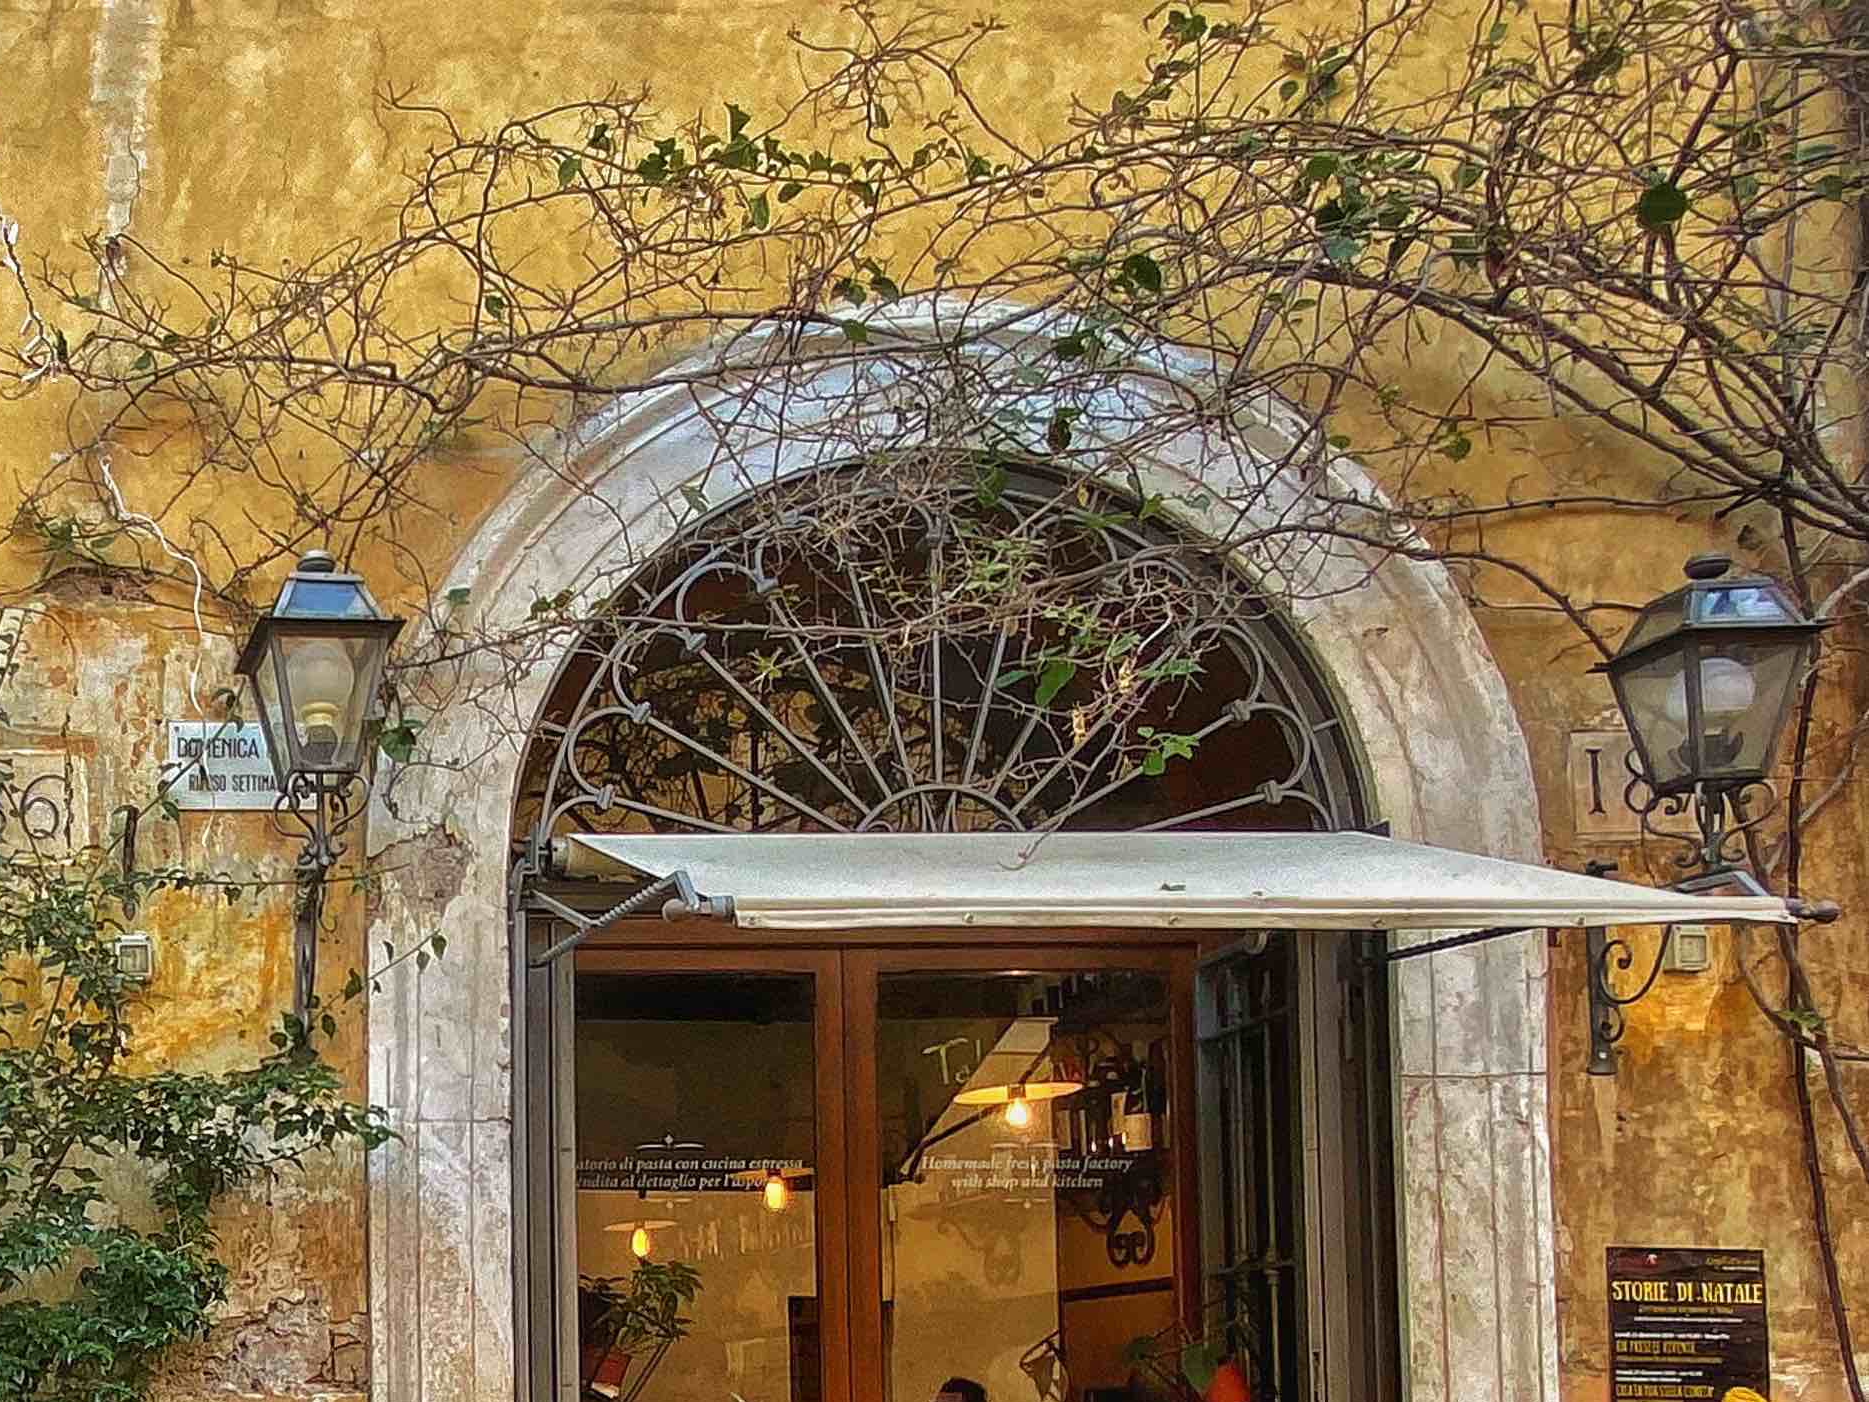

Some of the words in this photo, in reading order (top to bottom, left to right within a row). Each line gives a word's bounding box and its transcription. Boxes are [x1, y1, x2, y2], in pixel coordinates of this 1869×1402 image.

[176, 737, 260, 759] DOMENICA
[619, 1157, 635, 1170] di
[636, 1158, 679, 1174] pasta
[681, 1161, 699, 1170] con
[701, 1157, 746, 1170] cucina
[748, 1159, 803, 1172] espressa
[921, 1156, 1003, 1171] Homemade
[1006, 1156, 1039, 1173] fresh
[1081, 1156, 1134, 1173] factory
[620, 1174, 635, 1188] al
[636, 1174, 697, 1191] dettaglio
[698, 1177, 722, 1191] per
[951, 1173, 981, 1189] with
[984, 1173, 1019, 1192] shop
[1021, 1173, 1050, 1189] and
[1052, 1173, 1104, 1189] kitchen
[1611, 1281, 1669, 1302] STORIE
[1676, 1282, 1693, 1302] DI
[1702, 1281, 1762, 1304] NATALE
